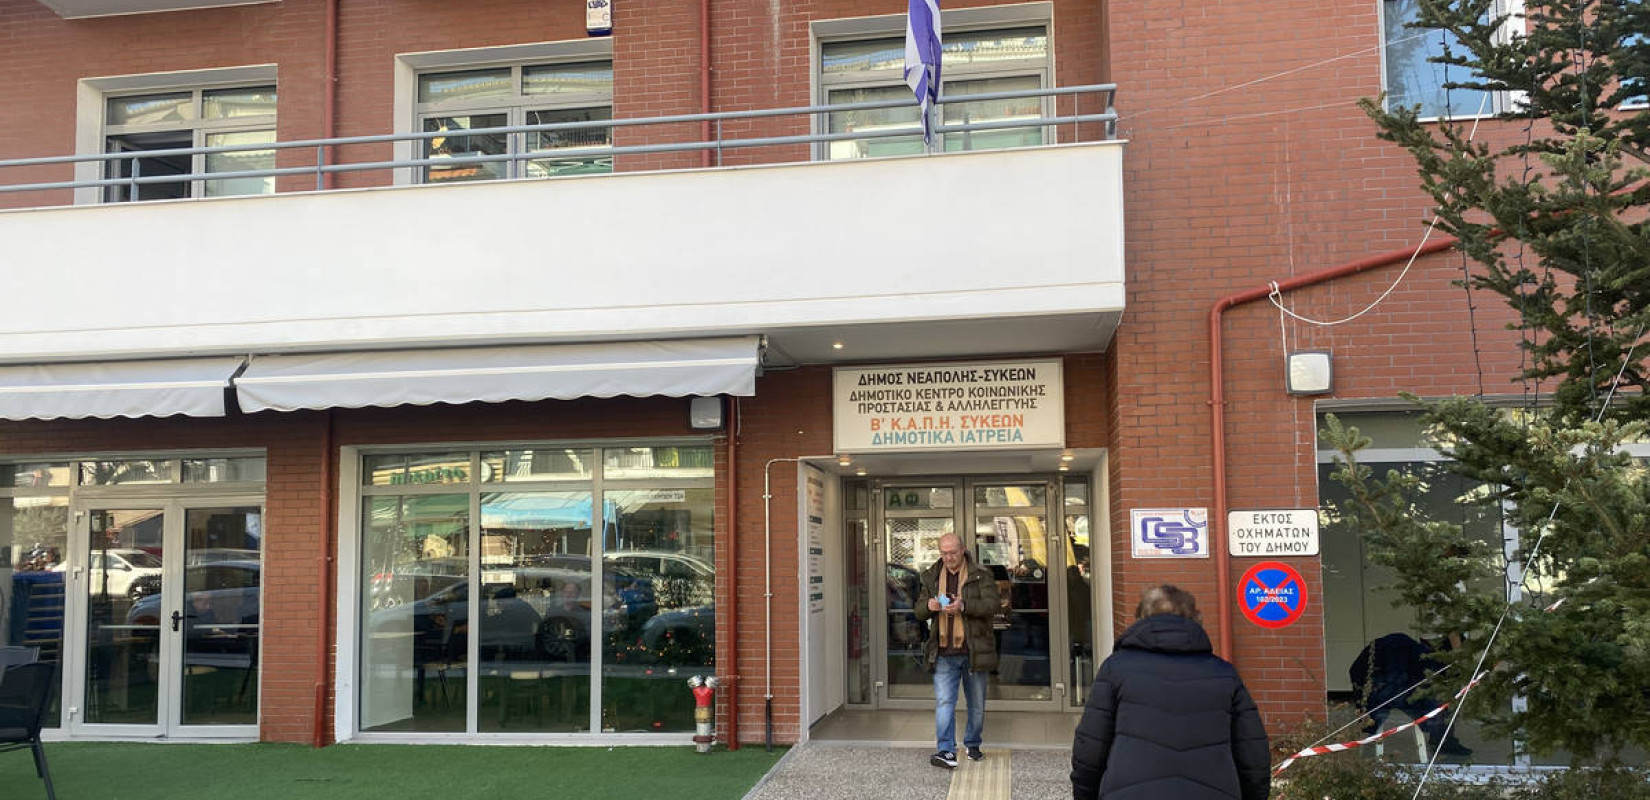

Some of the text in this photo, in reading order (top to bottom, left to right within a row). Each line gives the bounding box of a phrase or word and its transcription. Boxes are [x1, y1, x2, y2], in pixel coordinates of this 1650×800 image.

[858, 368, 1036, 386] ΔΗΜΟΣ ΝΕΑΠΟΛΗΣ-ΣΥΚΕΩΝ
[849, 385, 1046, 402] ΔΗΜΟΤΙΚΟ ΚΕΝΤΡΟ ΚΟΙΝΩΝΙΚΗΣ
[858, 398, 1037, 414] ΠΡΟΣΤΑΣΙΑΣ & ΑΛΛΗΛΕΓΓΥΗΣ
[891, 416, 955, 430] Κ.Α.Π.Η.
[960, 415, 1024, 429] ΣΥΚΕΩΝ
[872, 429, 1024, 445] ΔΗΜΟΤΙΚΑ ΙΑΤΡΕΙΑ
[1253, 513, 1293, 525] ΕΚΤΟΣ
[1237, 527, 1310, 539] ΟΧΗΜΑΤΩΝ
[1239, 541, 1309, 553] ΤΟΥ ΔΗΜΟΥ
